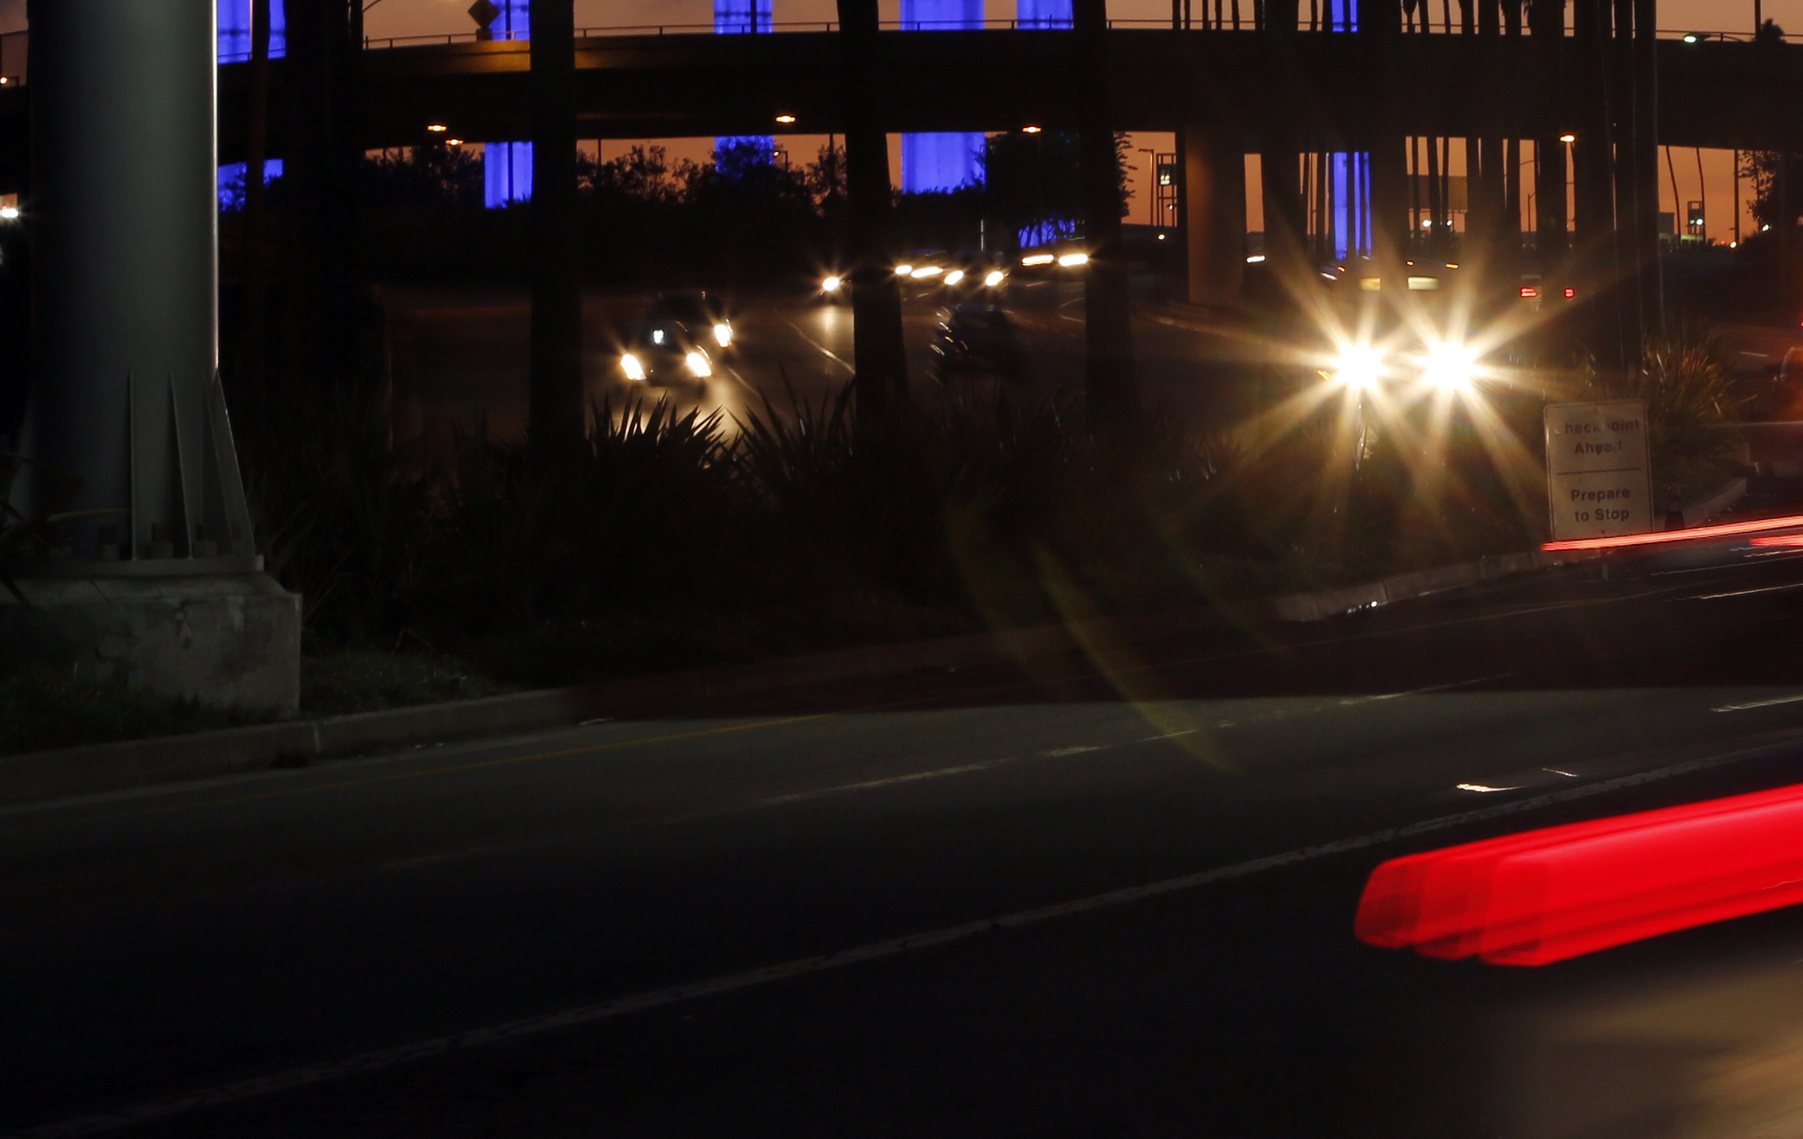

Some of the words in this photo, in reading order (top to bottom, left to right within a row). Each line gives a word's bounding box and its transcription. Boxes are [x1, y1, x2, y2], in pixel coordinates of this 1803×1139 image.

[1556, 419, 1640, 435] heckoint
[1574, 440, 1622, 455] Ahead
[1570, 488, 1631, 503] Prepare
[1574, 511, 1590, 522] to
[1594, 508, 1630, 522] Stop
